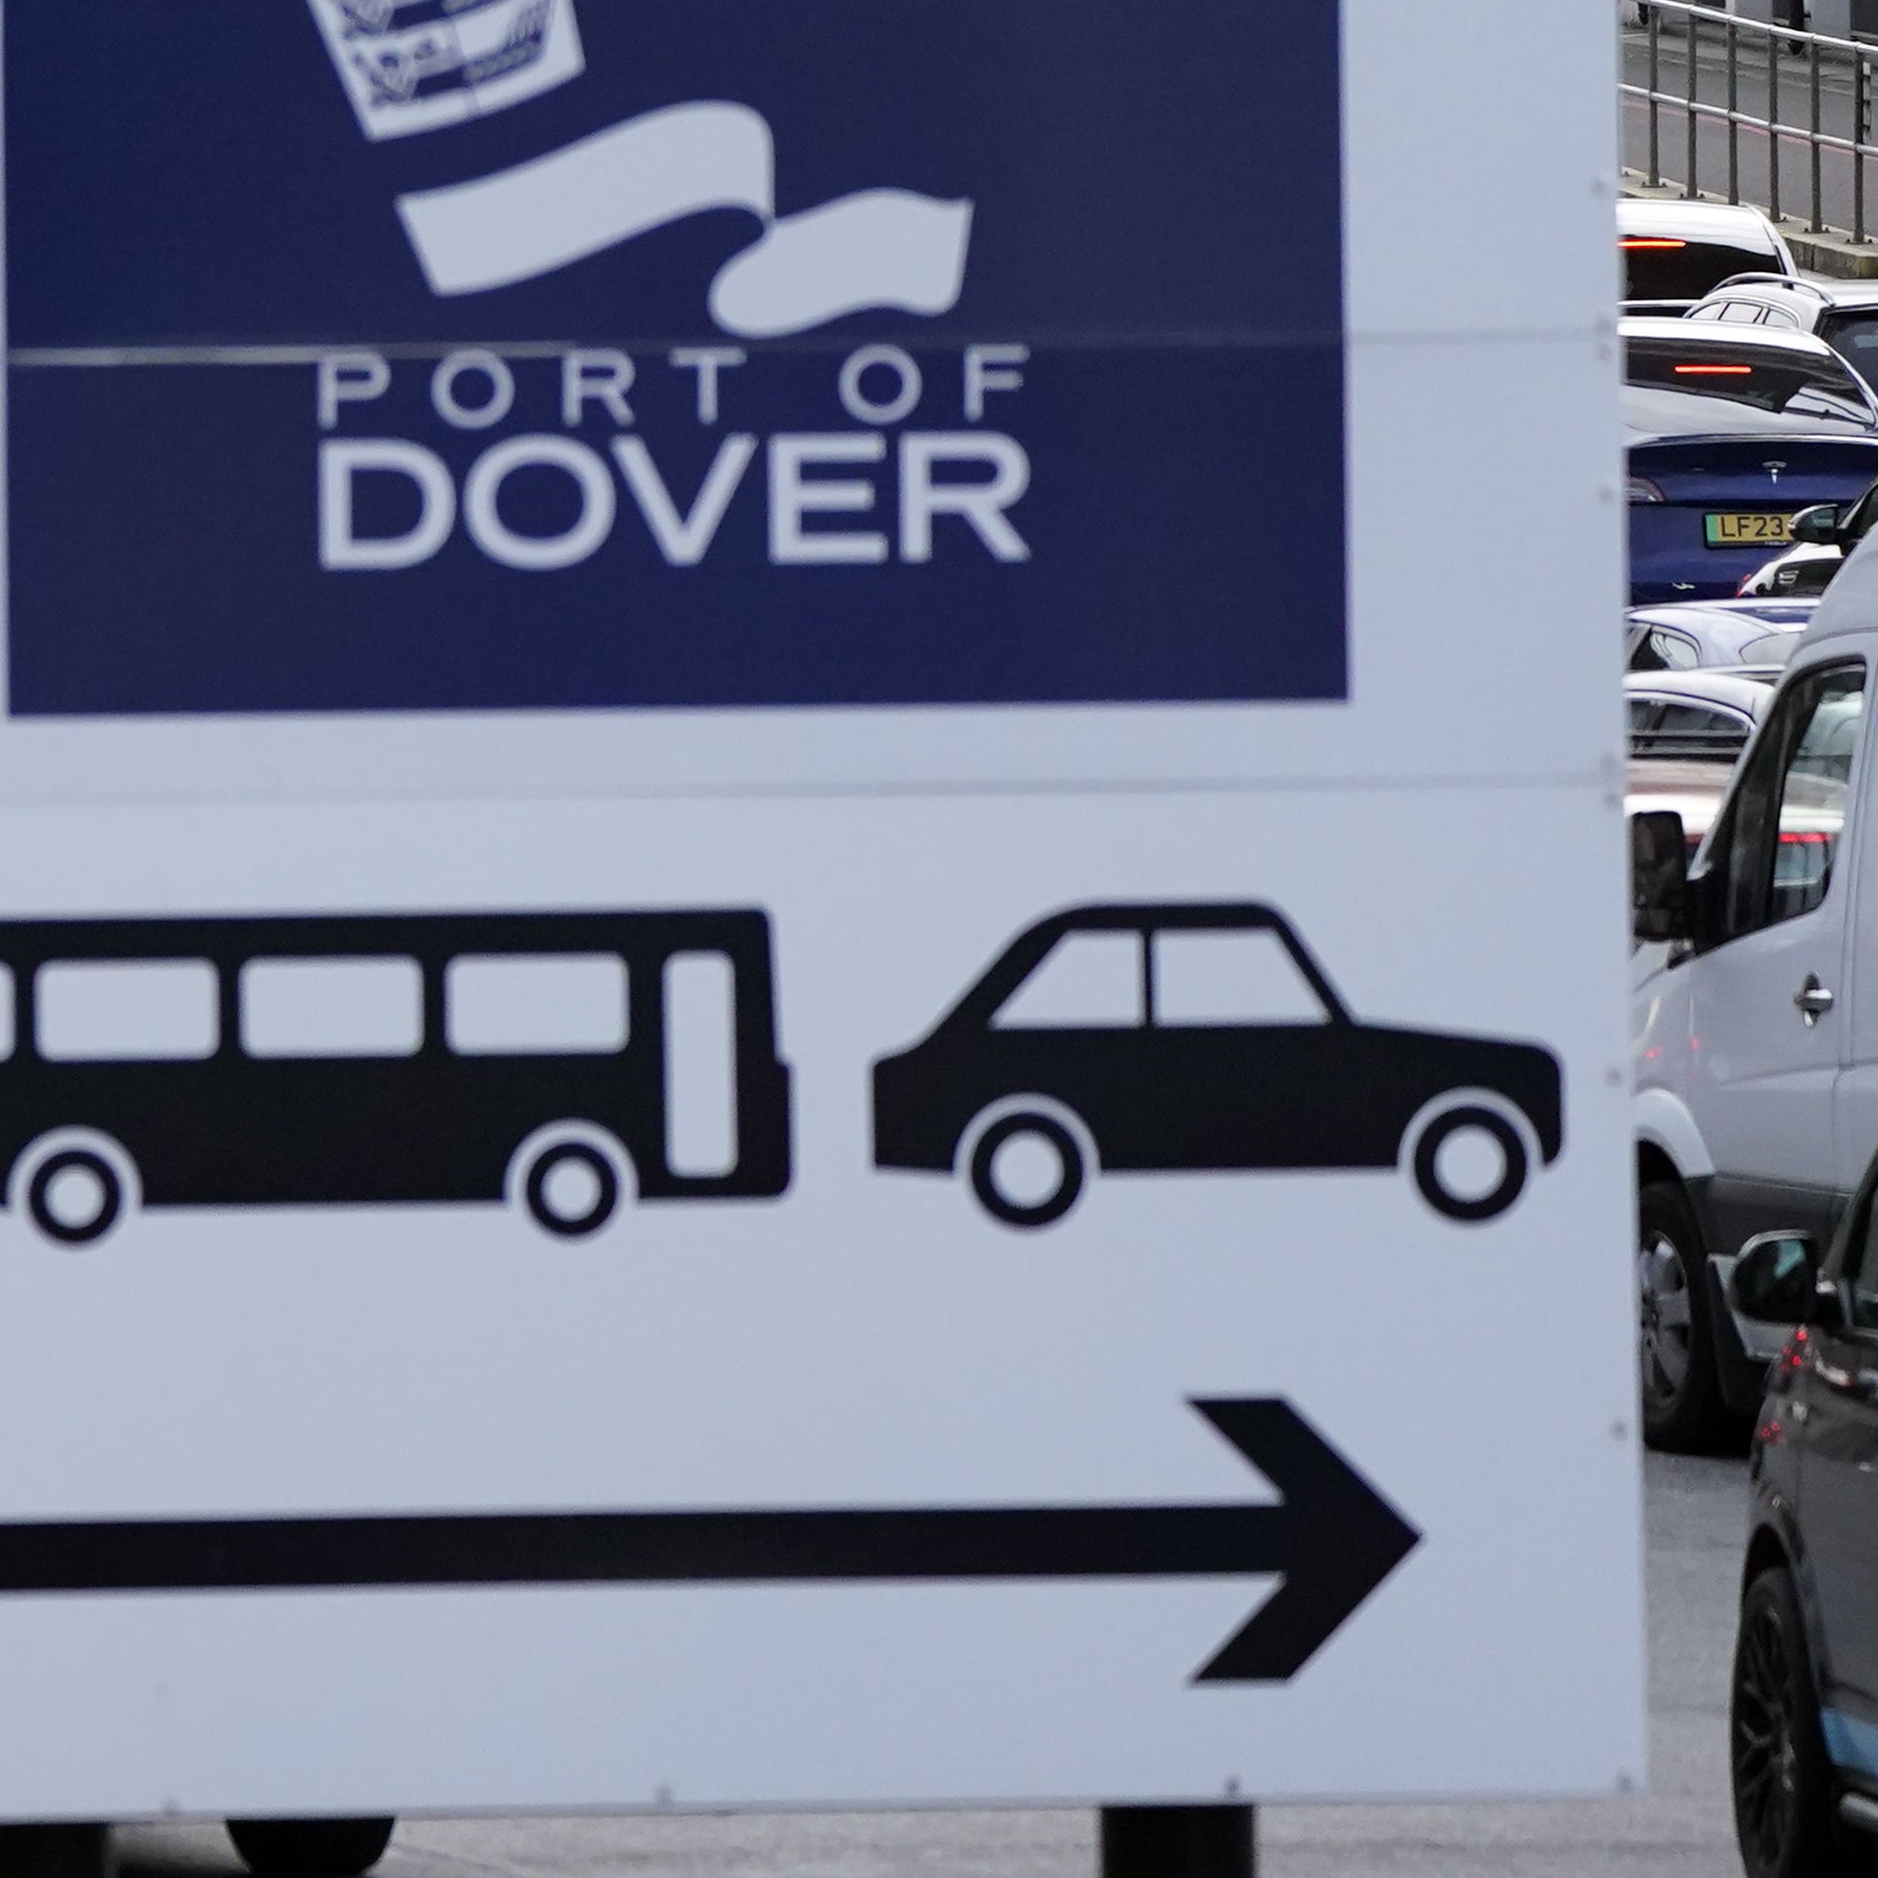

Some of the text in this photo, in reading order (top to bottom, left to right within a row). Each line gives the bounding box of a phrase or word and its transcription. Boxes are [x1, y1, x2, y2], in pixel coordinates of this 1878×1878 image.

[317, 343, 1033, 430] PORT OF
[318, 430, 1034, 572] DOVER
[1720, 516, 1785, 538] LF23
